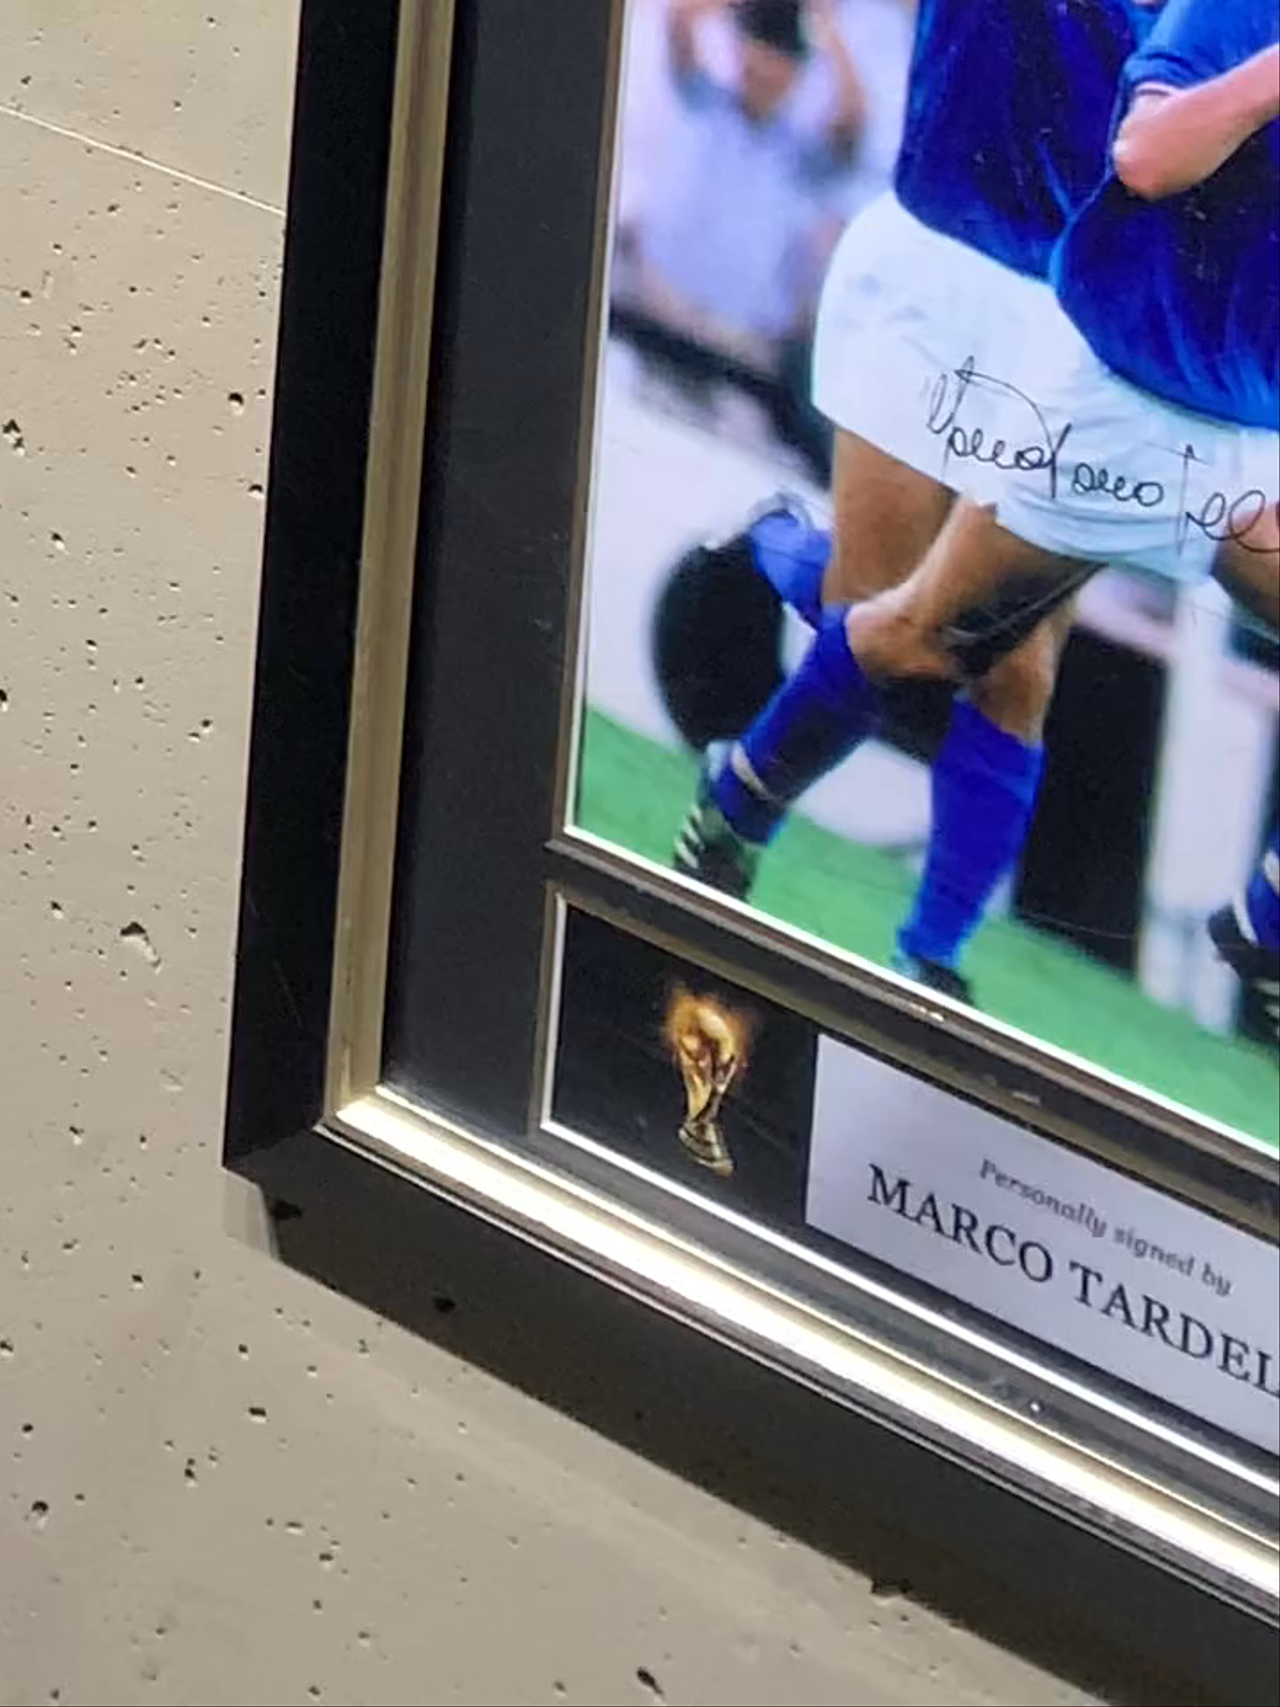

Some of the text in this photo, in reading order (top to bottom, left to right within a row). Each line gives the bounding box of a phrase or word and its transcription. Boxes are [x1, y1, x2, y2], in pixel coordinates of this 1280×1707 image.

[867, 1163, 1054, 1285] MARCO
[980, 1158, 1233, 1296] Personally signed by
